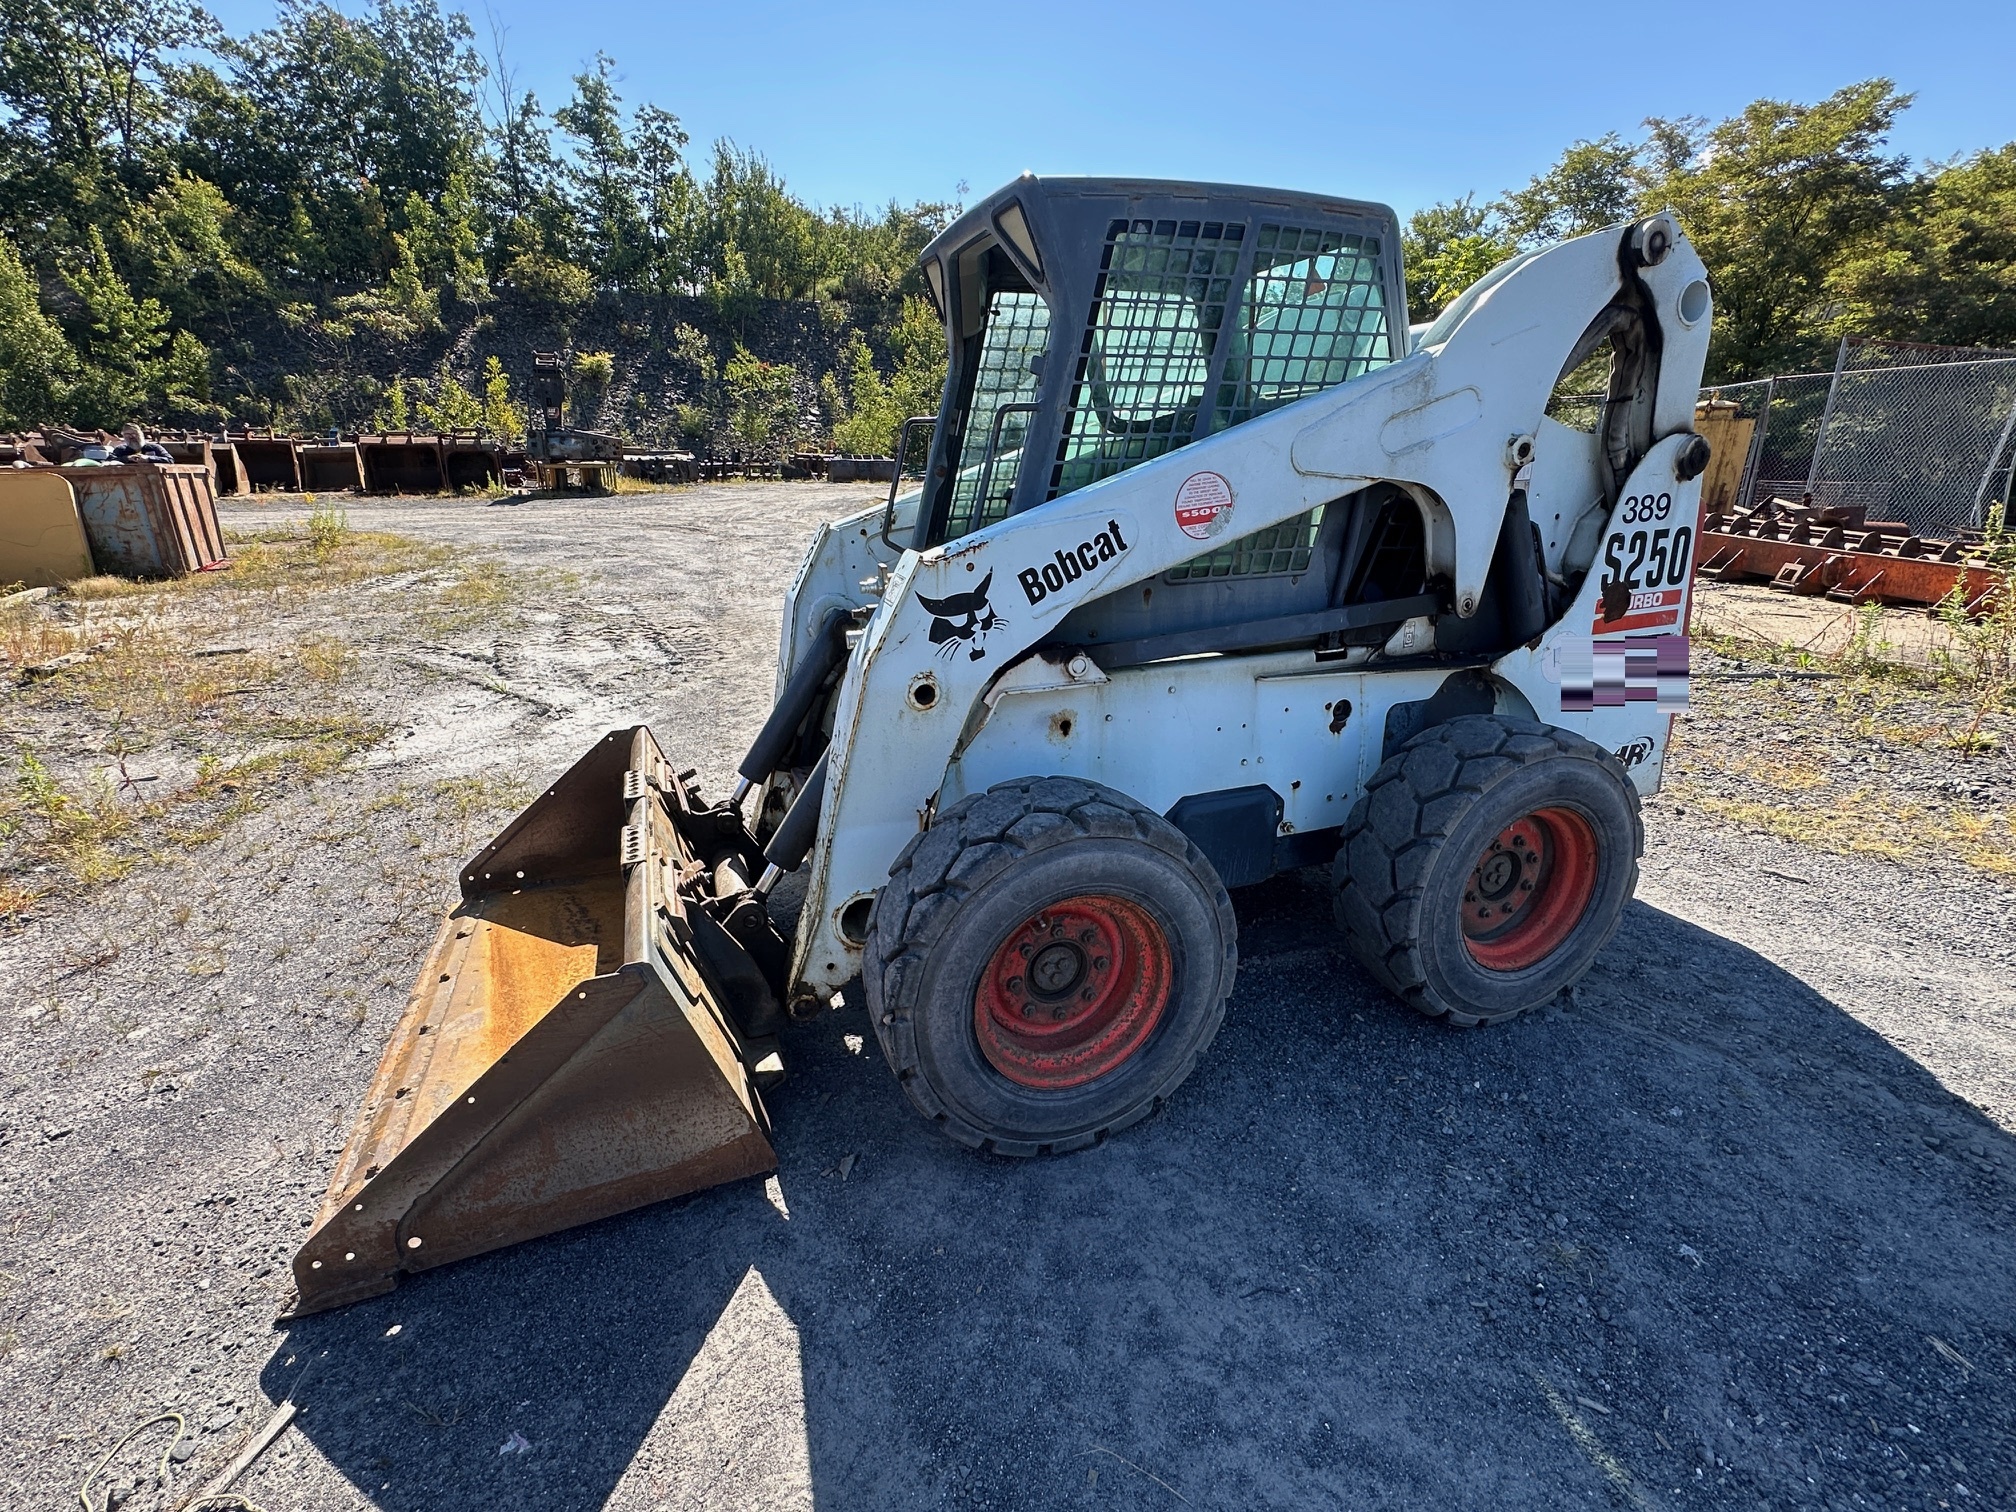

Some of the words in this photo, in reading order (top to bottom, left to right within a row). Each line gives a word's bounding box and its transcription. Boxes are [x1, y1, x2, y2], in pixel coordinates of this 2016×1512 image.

[1622, 493, 1671, 524] 389
[1017, 519, 1128, 606] Bobcat
[1601, 526, 1692, 591] S250
